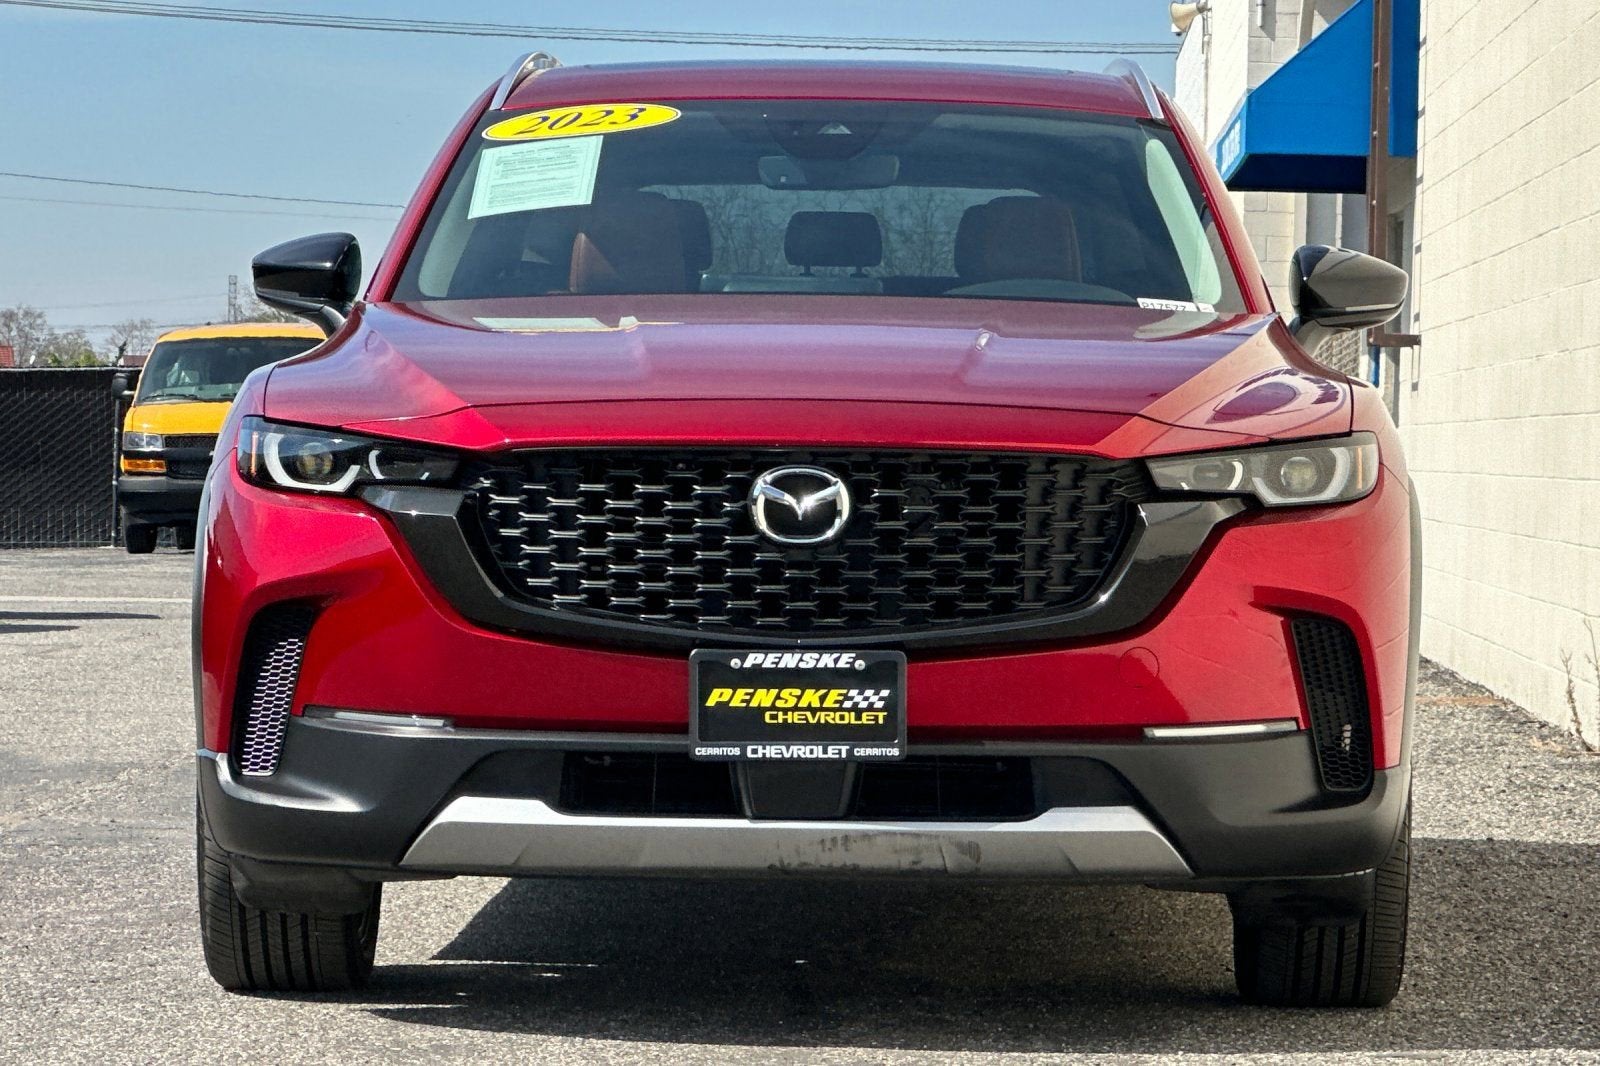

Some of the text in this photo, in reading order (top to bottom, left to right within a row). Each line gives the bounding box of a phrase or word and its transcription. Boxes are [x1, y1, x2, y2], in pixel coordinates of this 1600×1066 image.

[513, 107, 647, 135] 2023
[743, 652, 856, 668] PENSKE
[705, 688, 848, 708] PENSKE
[764, 711, 888, 725] CHEVROLET
[695, 745, 900, 759] CERRITOS CHEVROLET CERRITOS
